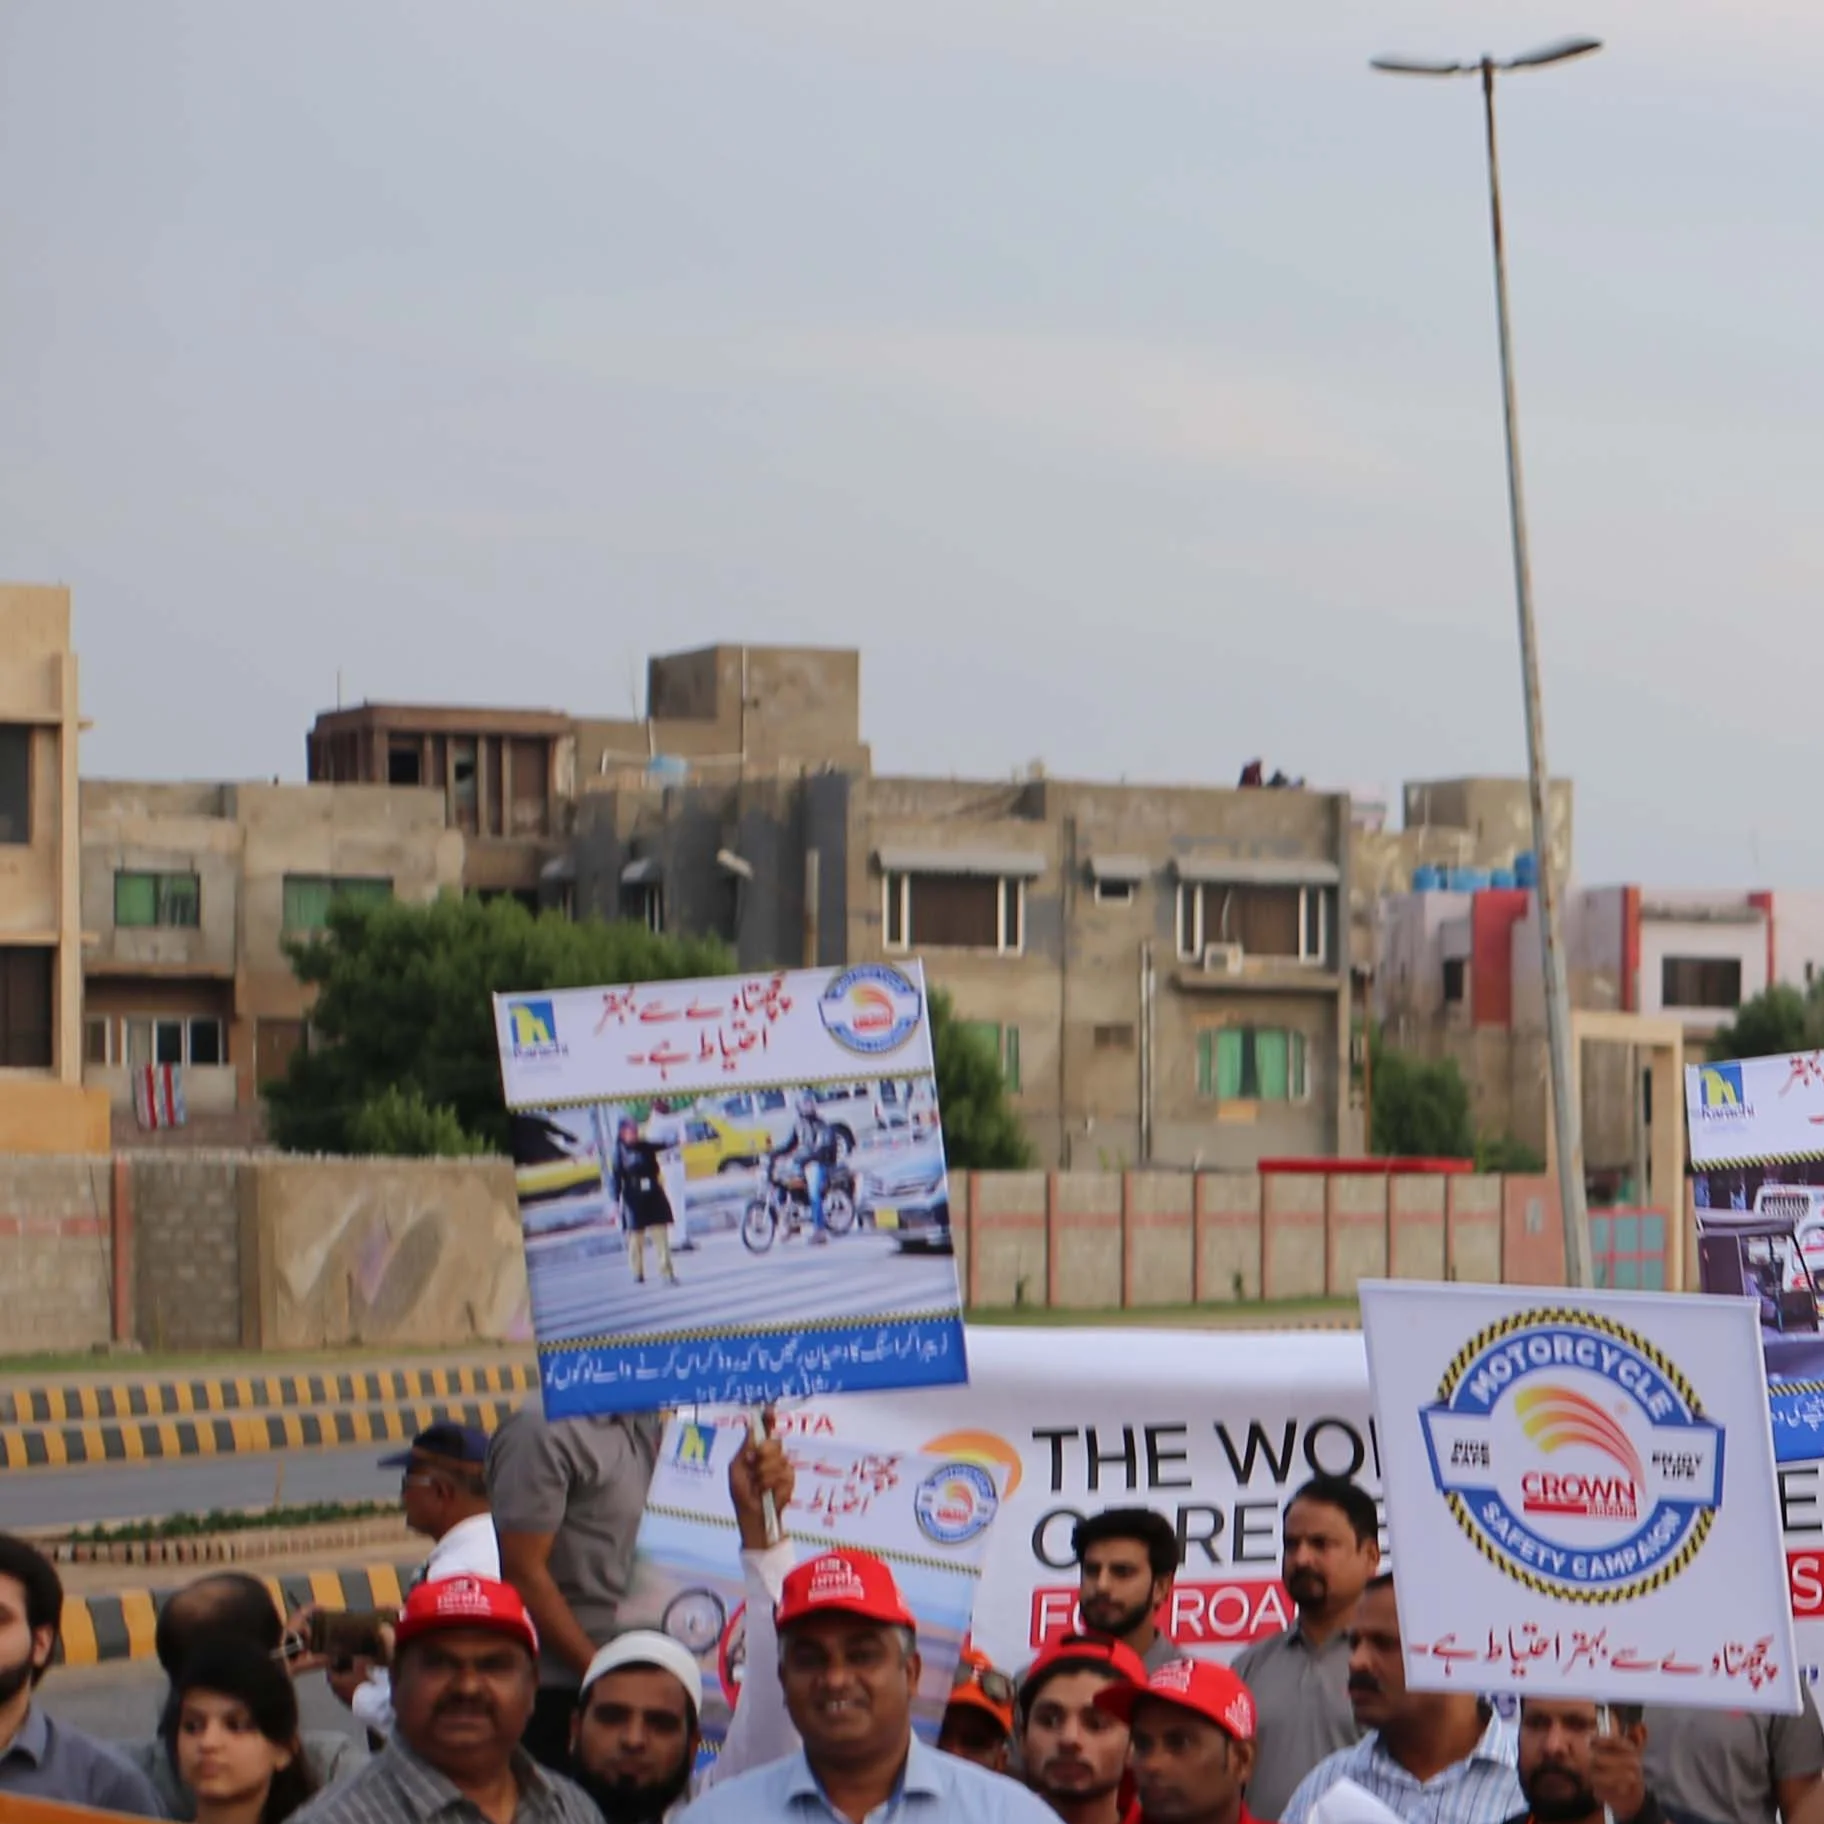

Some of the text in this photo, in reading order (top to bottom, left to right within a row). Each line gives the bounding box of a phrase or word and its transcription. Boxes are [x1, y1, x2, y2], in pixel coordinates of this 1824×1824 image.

[1469, 1334, 1675, 1420] MOTORCYCLE
[1032, 1423, 1192, 1494] THE
[1651, 1452, 1704, 1468] ENJOY
[1662, 1464, 1696, 1480] LIFE
[1521, 1471, 1637, 1502] CROWN
[1483, 1501, 1682, 1580] SAFETY CAMPAIGN
[1171, 1585, 1300, 1638] ROA
